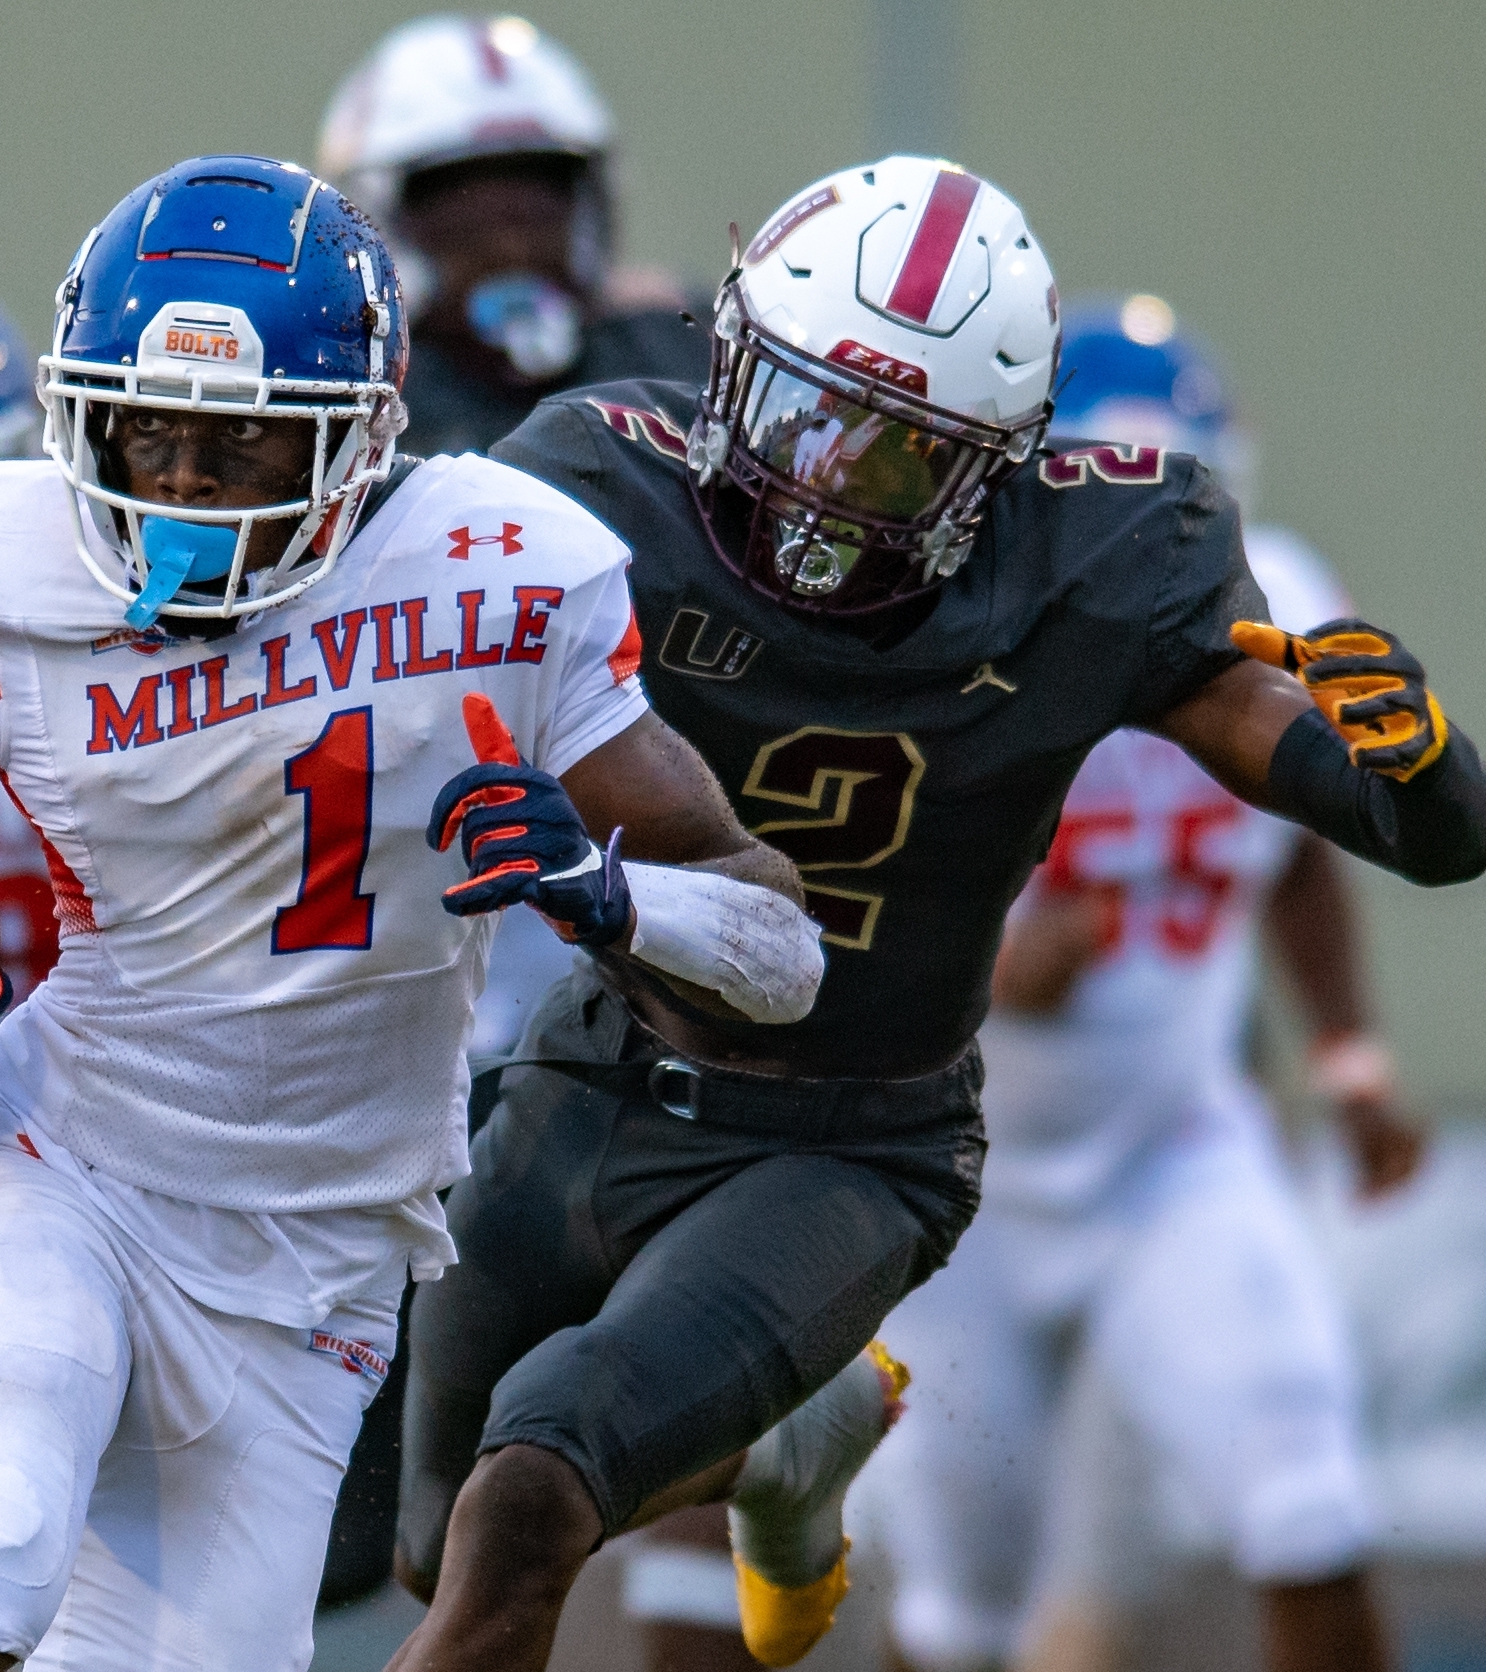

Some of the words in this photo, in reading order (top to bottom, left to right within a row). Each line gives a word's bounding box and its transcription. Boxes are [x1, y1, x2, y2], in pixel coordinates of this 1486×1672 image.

[165, 331, 239, 360] BOLTS
[86, 585, 565, 756] MILLVILLE
[271, 705, 376, 956] 1
[742, 727, 925, 951] 2
[313, 1333, 389, 1377] MILLVILLE
